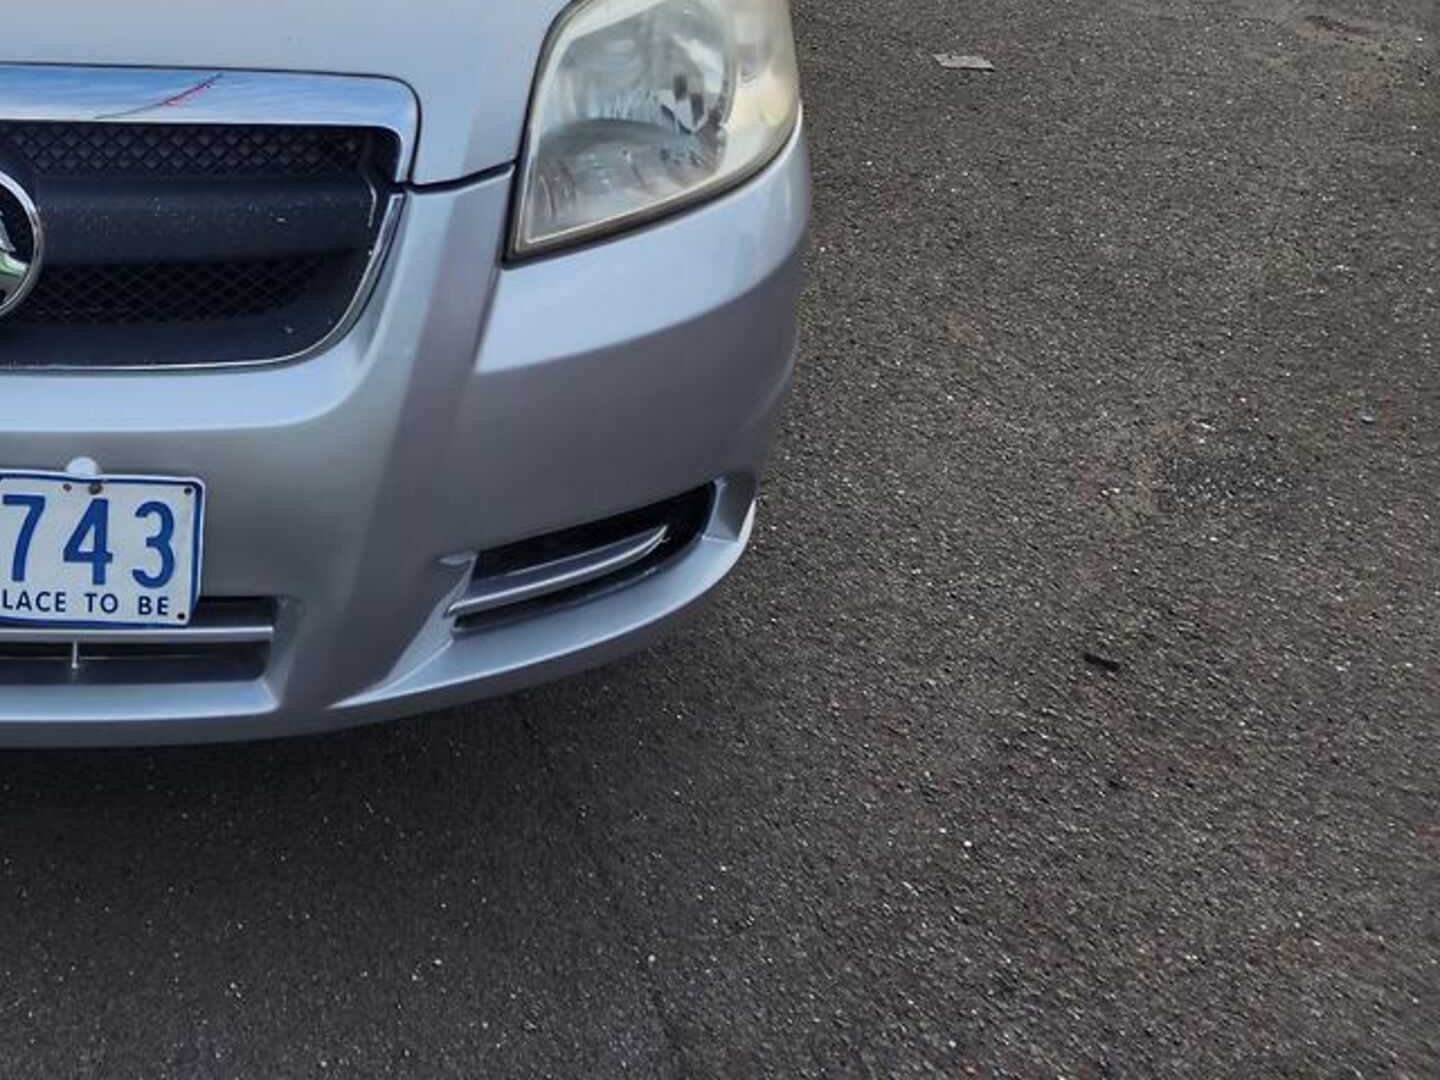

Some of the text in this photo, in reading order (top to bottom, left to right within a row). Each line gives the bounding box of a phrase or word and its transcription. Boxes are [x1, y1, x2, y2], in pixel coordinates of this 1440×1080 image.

[2, 494, 176, 589] 743
[85, 592, 119, 615] TO
[139, 596, 170, 616] BE
